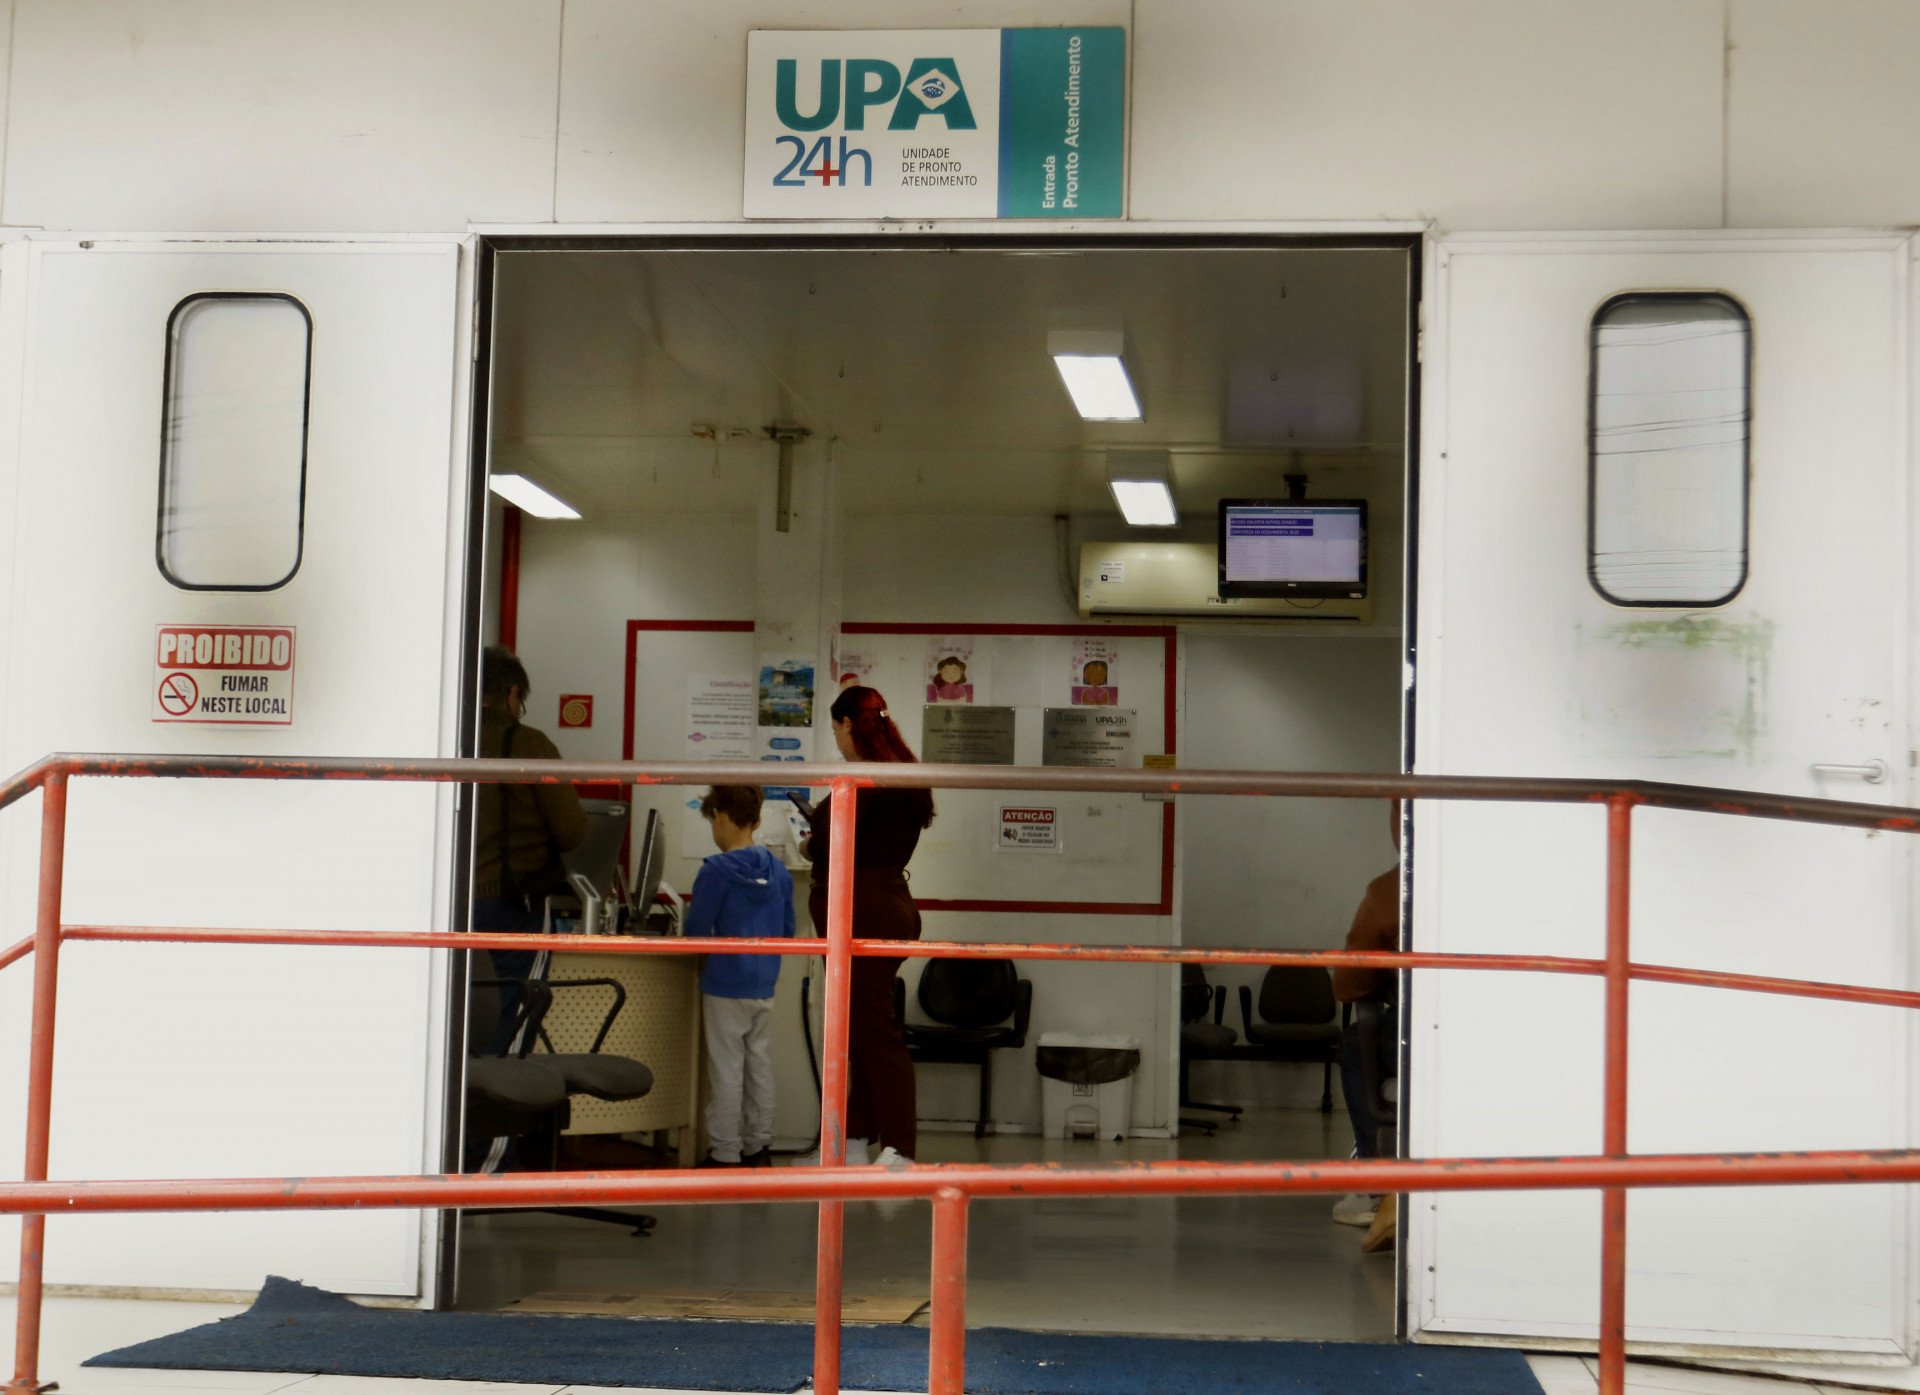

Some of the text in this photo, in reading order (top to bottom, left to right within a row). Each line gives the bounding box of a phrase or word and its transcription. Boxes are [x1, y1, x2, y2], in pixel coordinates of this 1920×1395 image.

[775, 57, 978, 132] UPA
[1063, 36, 1082, 209] Pronto Atendimento
[772, 136, 873, 187] 24h
[902, 148, 950, 159] UNIDADE
[902, 162, 962, 173] DE PRONTO
[901, 175, 978, 187] ATENDIMENTO
[1043, 155, 1056, 209] Entrada
[159, 633, 290, 666] PROIBIDO
[221, 675, 268, 692] FUMAR
[201, 697, 287, 714] NESTE LOCAL
[1004, 811, 1052, 822] ATENÇÃO
